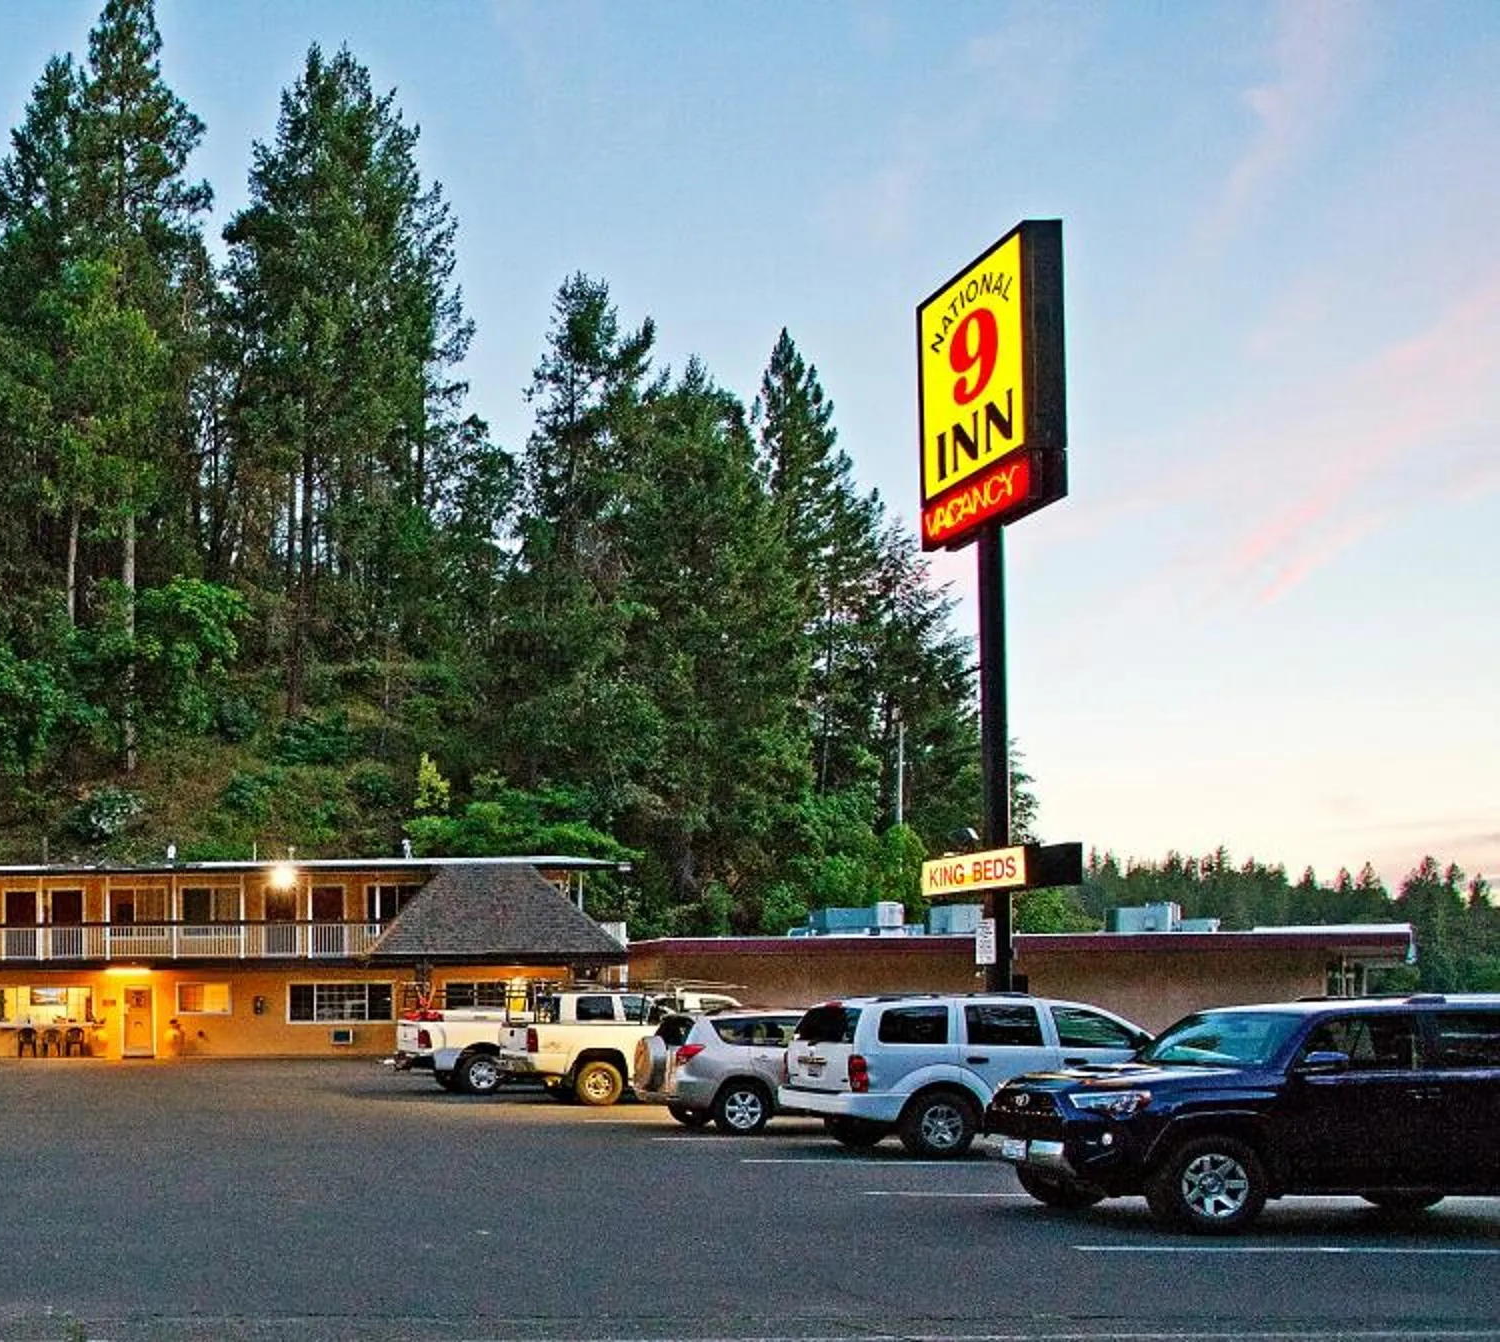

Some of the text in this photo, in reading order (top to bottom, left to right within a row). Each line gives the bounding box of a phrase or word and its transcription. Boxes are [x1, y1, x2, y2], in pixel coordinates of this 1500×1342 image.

[931, 271, 1013, 353] NATIONAL
[949, 307, 999, 406] 9
[936, 388, 1013, 482] INN
[925, 465, 1019, 536] VACANCY
[929, 856, 1016, 888] KING BEDS
